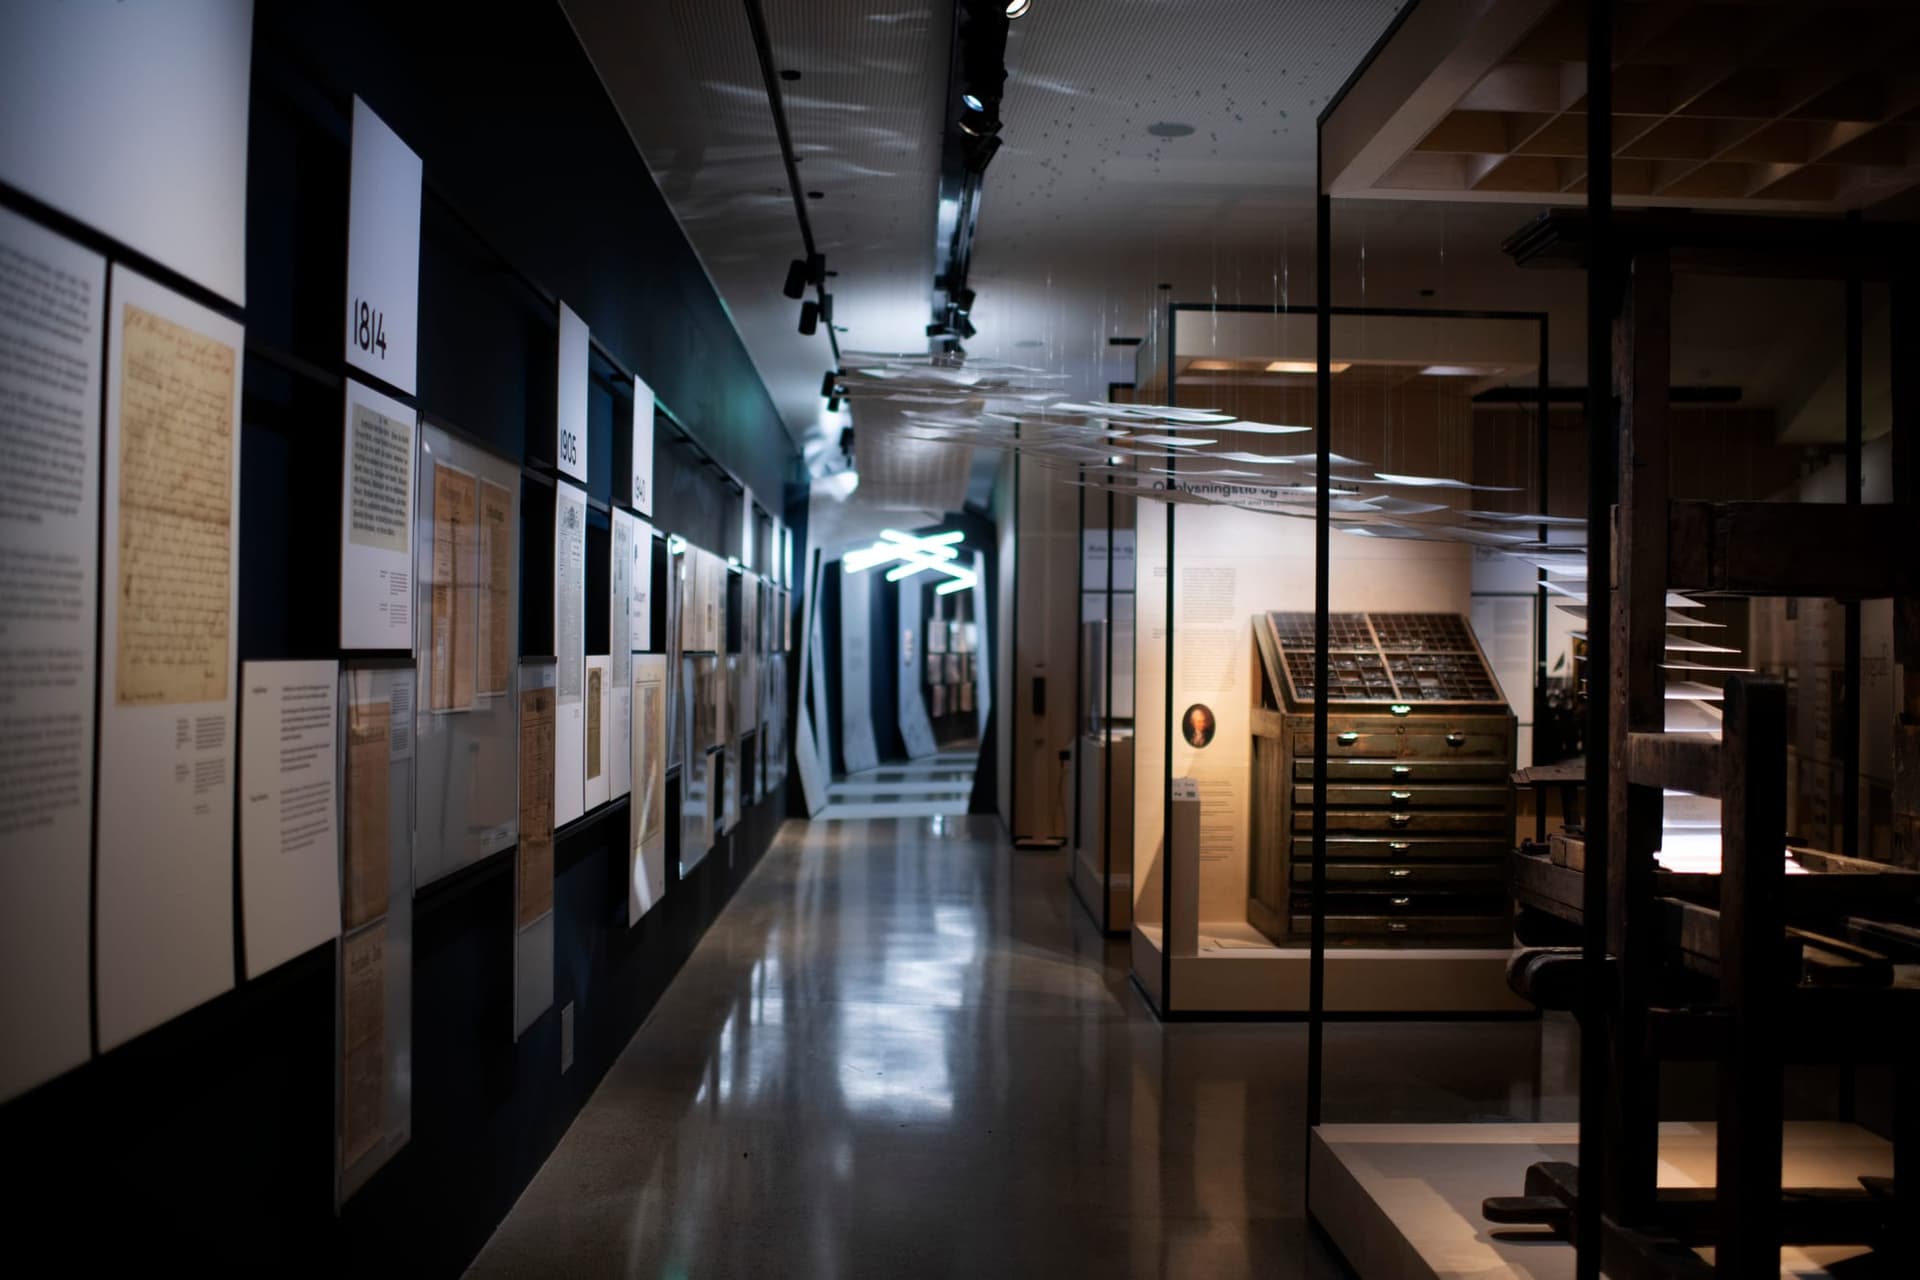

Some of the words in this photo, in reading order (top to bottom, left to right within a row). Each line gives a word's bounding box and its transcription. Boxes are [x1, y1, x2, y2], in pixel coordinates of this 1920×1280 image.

[354, 298, 387, 360] 1814
[560, 429, 577, 466] 1905
[1153, 481, 1256, 497] Olysningstid
